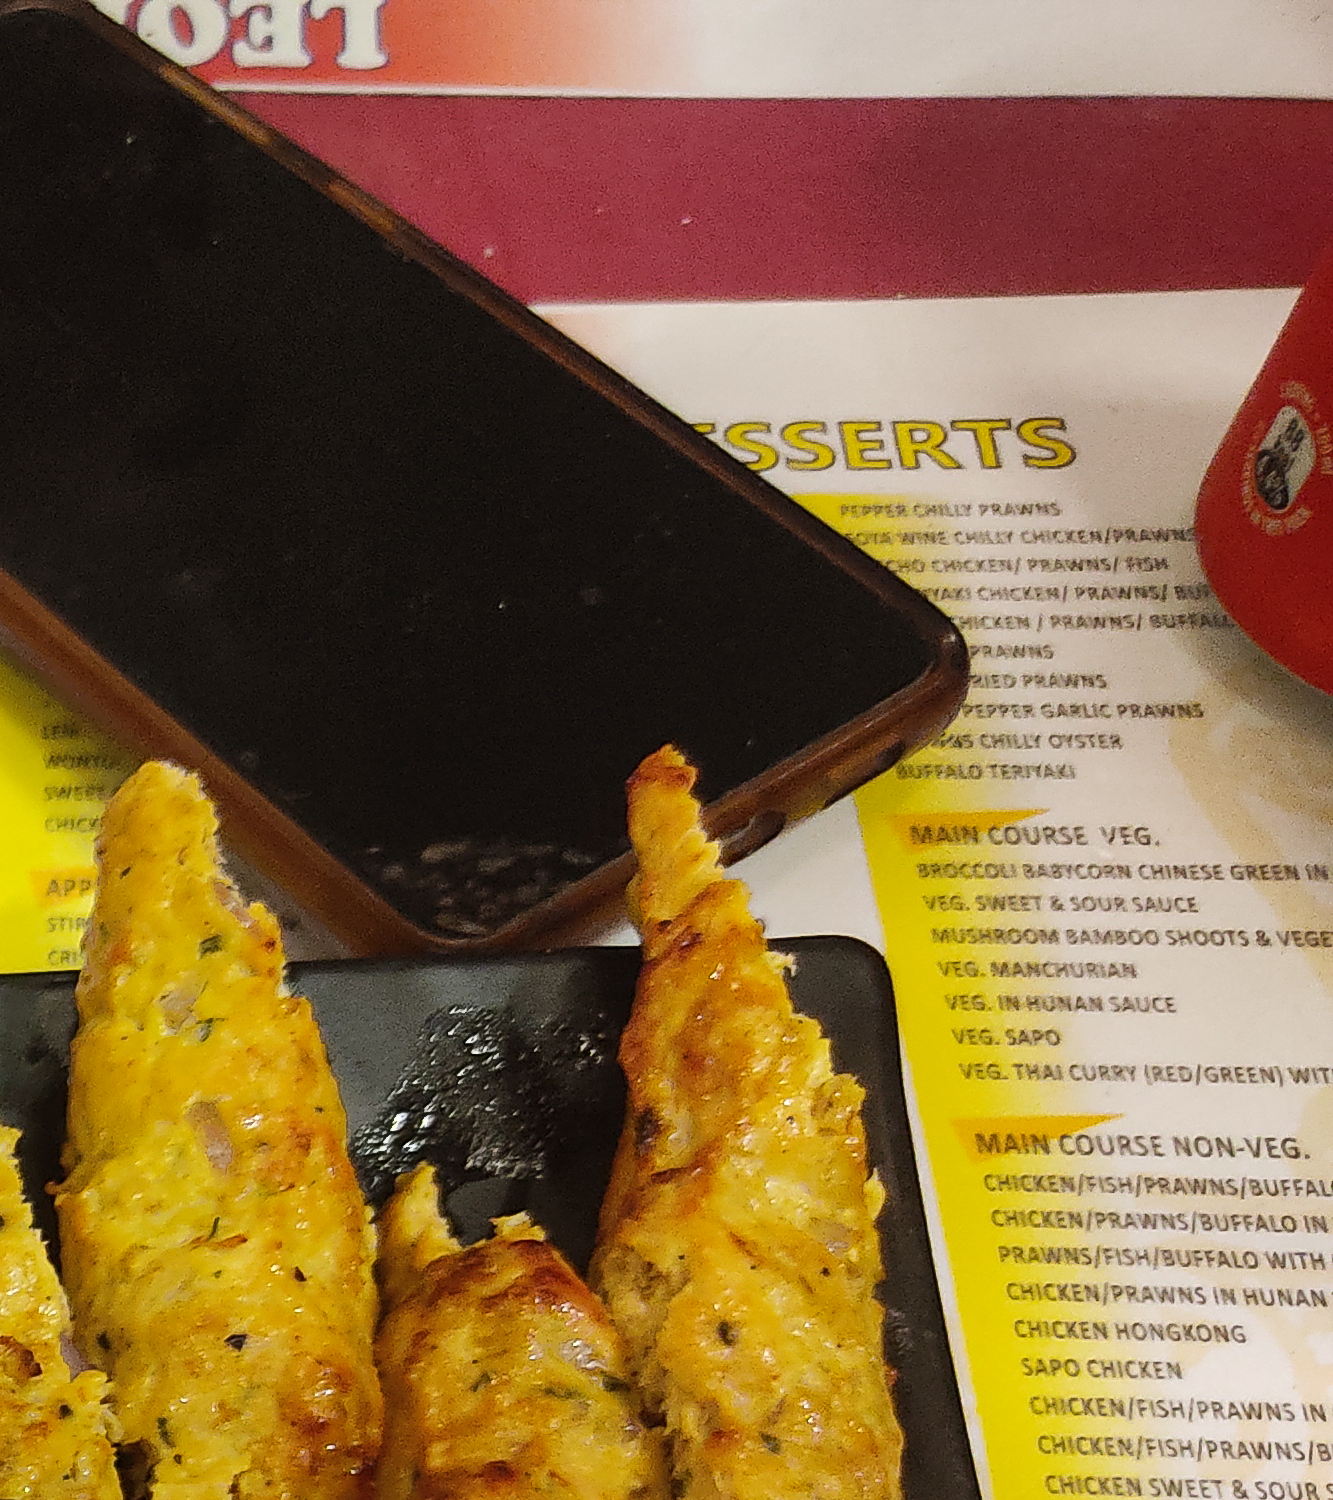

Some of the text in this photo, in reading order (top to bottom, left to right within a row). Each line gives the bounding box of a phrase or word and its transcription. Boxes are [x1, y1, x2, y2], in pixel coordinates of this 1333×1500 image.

[687, 417, 1078, 473] SSERTS
[1041, 704, 1111, 719] GARLIC
[1118, 704, 1203, 719] PRAWNS
[910, 825, 1159, 846] MAIN COURSE VEG.
[918, 863, 1328, 882] BROCCOLI BABYCORN CHINESE GREEN IN
[932, 929, 1273, 947] MUSHROOM BAMBOO SHOOTS &
[939, 962, 1138, 979] VEG. MANCHURIAN
[952, 1029, 1060, 1046] VEG. SAPO
[959, 1064, 1283, 1085] VEG. THAI CURRY (RED/GREEN)
[976, 1134, 1310, 1160] MAIN COURSE NON-VEG.
[985, 1174, 1333, 1198] CHICKEN/FISH/PRAWNS/BUFFAL
[999, 1246, 1325, 1270] PRAWNS/FISH/BUFFALO WITH
[1015, 1321, 1246, 1343] CHICKEN HONGKONG
[1022, 1359, 1182, 1379] SAPO CHICKEN
[1046, 1476, 1318, 1500] CHICKEN SWEET & SOUR
